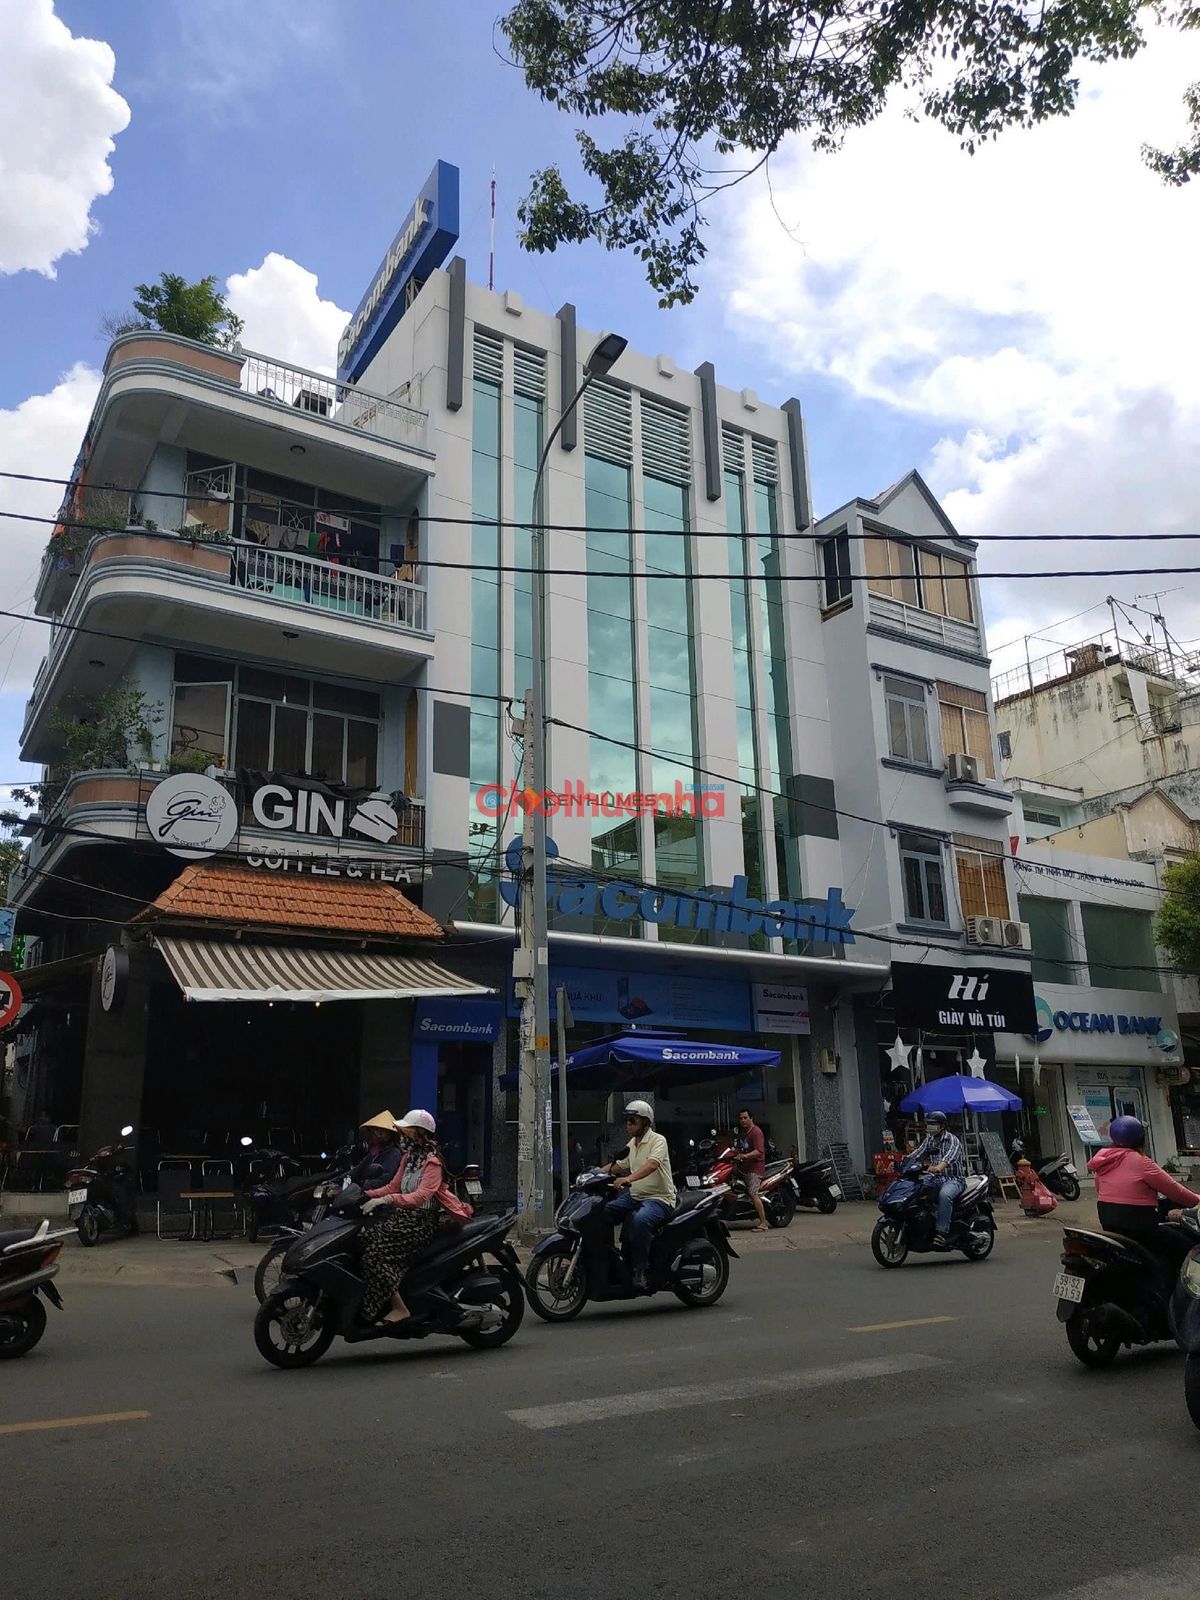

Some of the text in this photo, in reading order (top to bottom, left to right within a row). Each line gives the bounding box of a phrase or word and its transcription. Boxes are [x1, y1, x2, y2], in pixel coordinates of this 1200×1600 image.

[337, 199, 434, 368] Sacombank
[253, 784, 344, 837] GIN
[763, 989, 805, 1000] Sacombank
[420, 1017, 493, 1034] Sacombank
[938, 1008, 1006, 1028] GIÀY VÀ TÚI
[1053, 1010, 1162, 1035] OCEAN BANK
[662, 1048, 739, 1060] Sacombank
